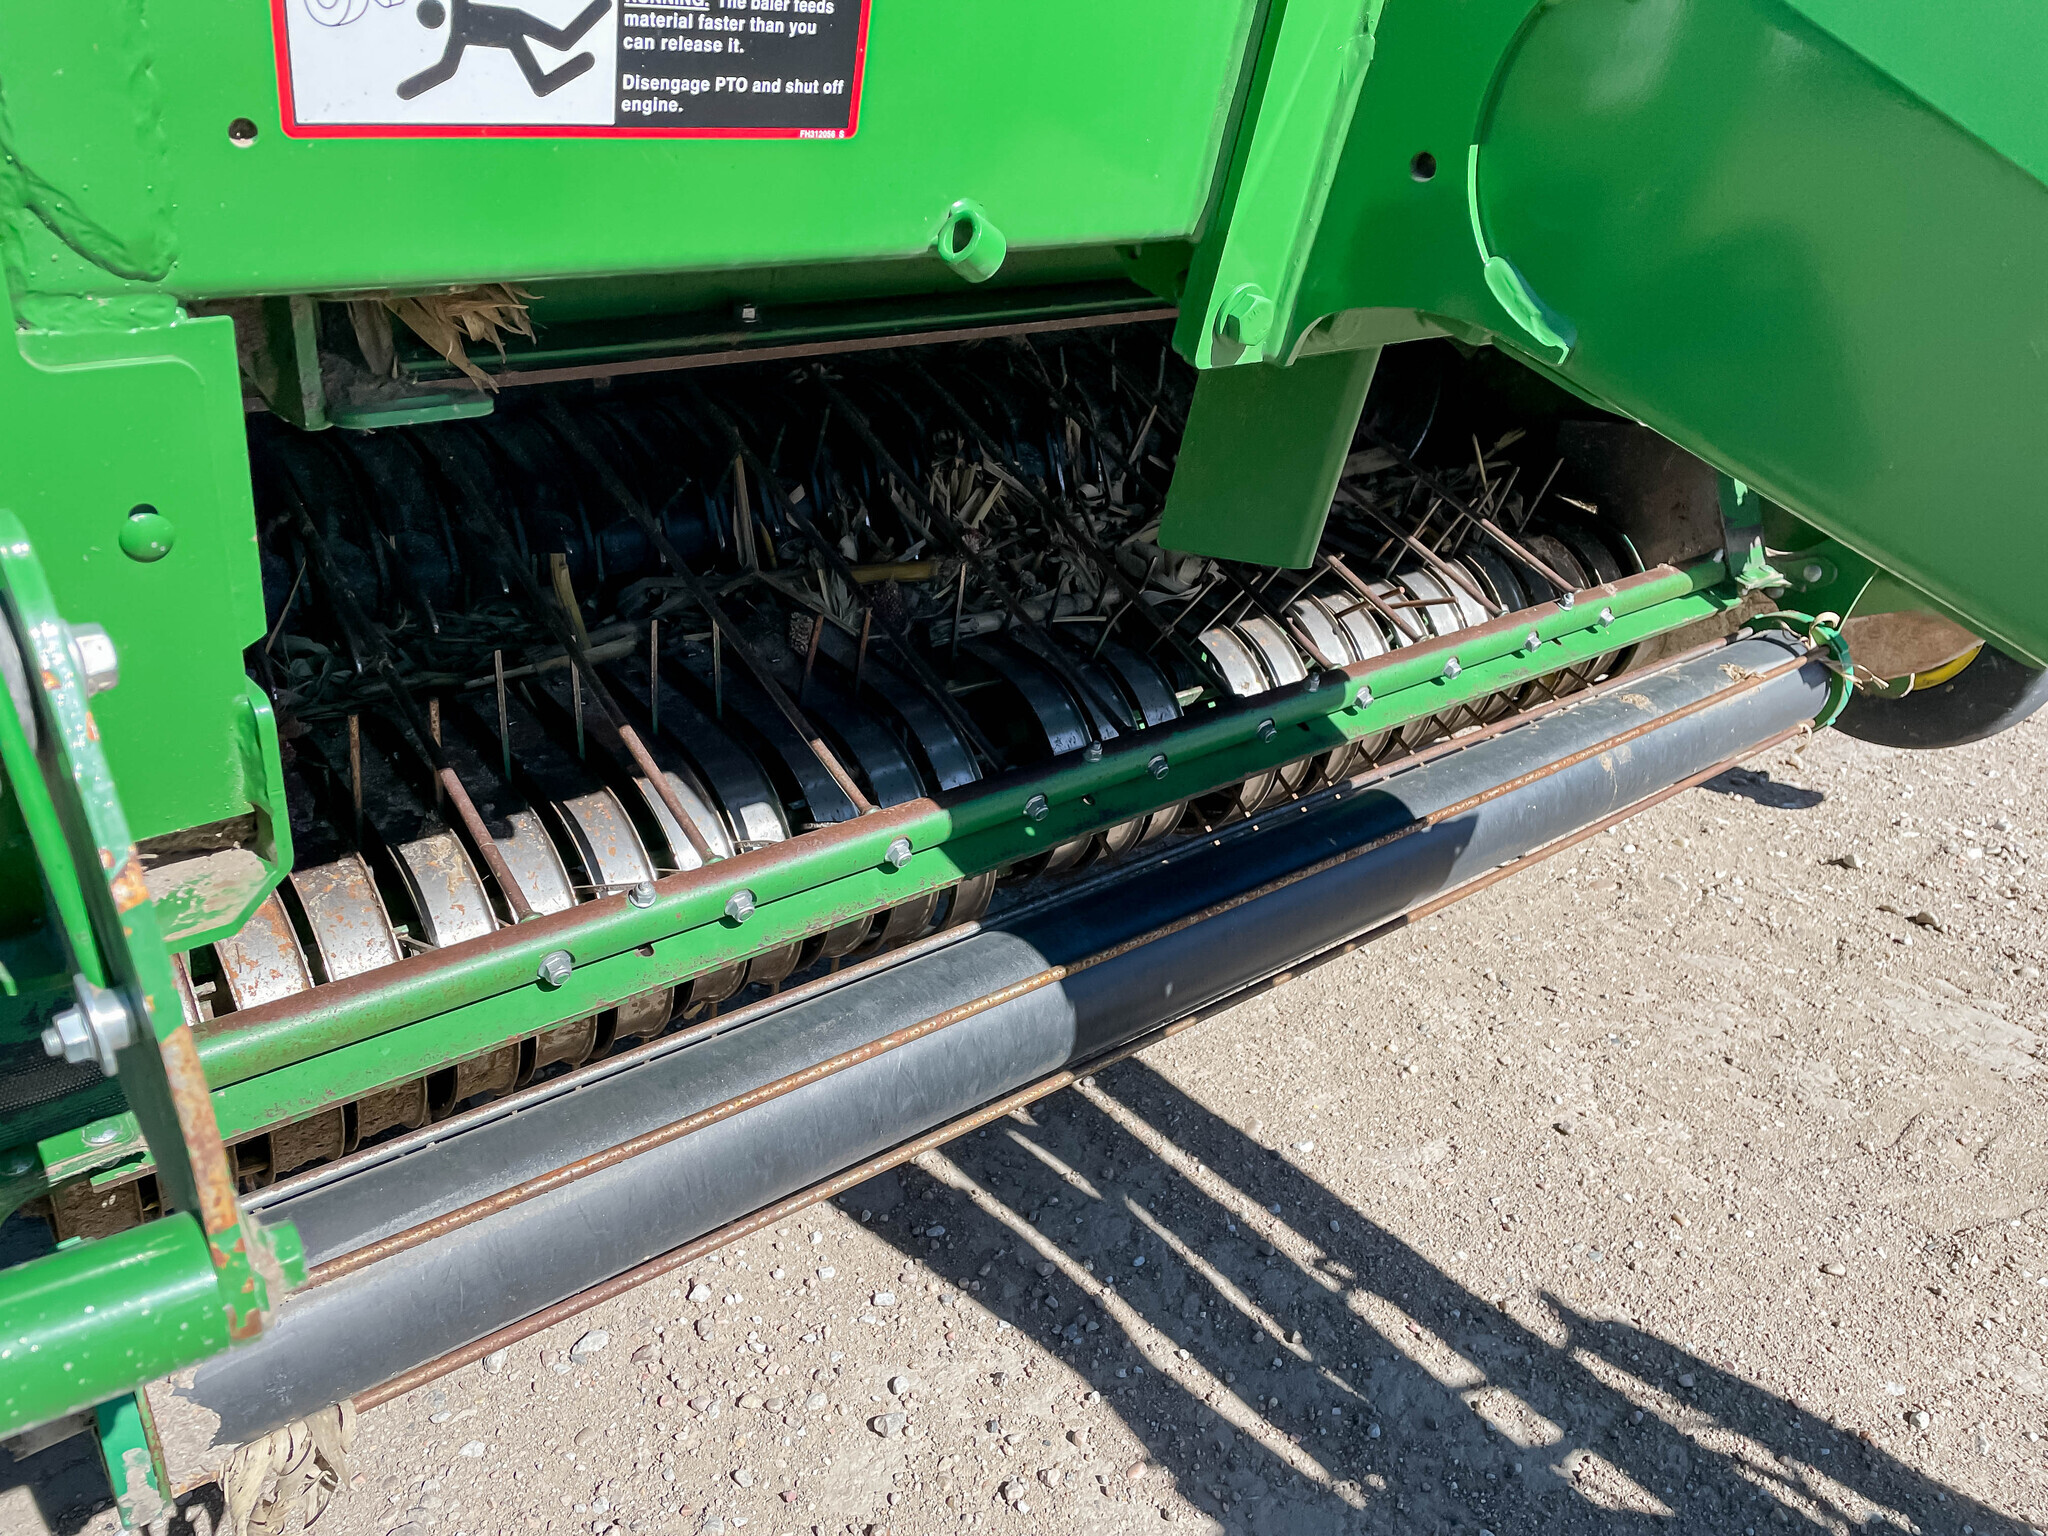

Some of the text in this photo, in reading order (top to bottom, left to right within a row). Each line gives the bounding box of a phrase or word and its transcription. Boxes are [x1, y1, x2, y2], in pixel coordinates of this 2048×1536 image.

[793, 0, 836, 15] feeds
[624, 11, 818, 38] material faster than you
[623, 36, 745, 54] can release it.
[622, 74, 845, 96] Disengage PTO and shut off
[621, 97, 685, 116] engine.
